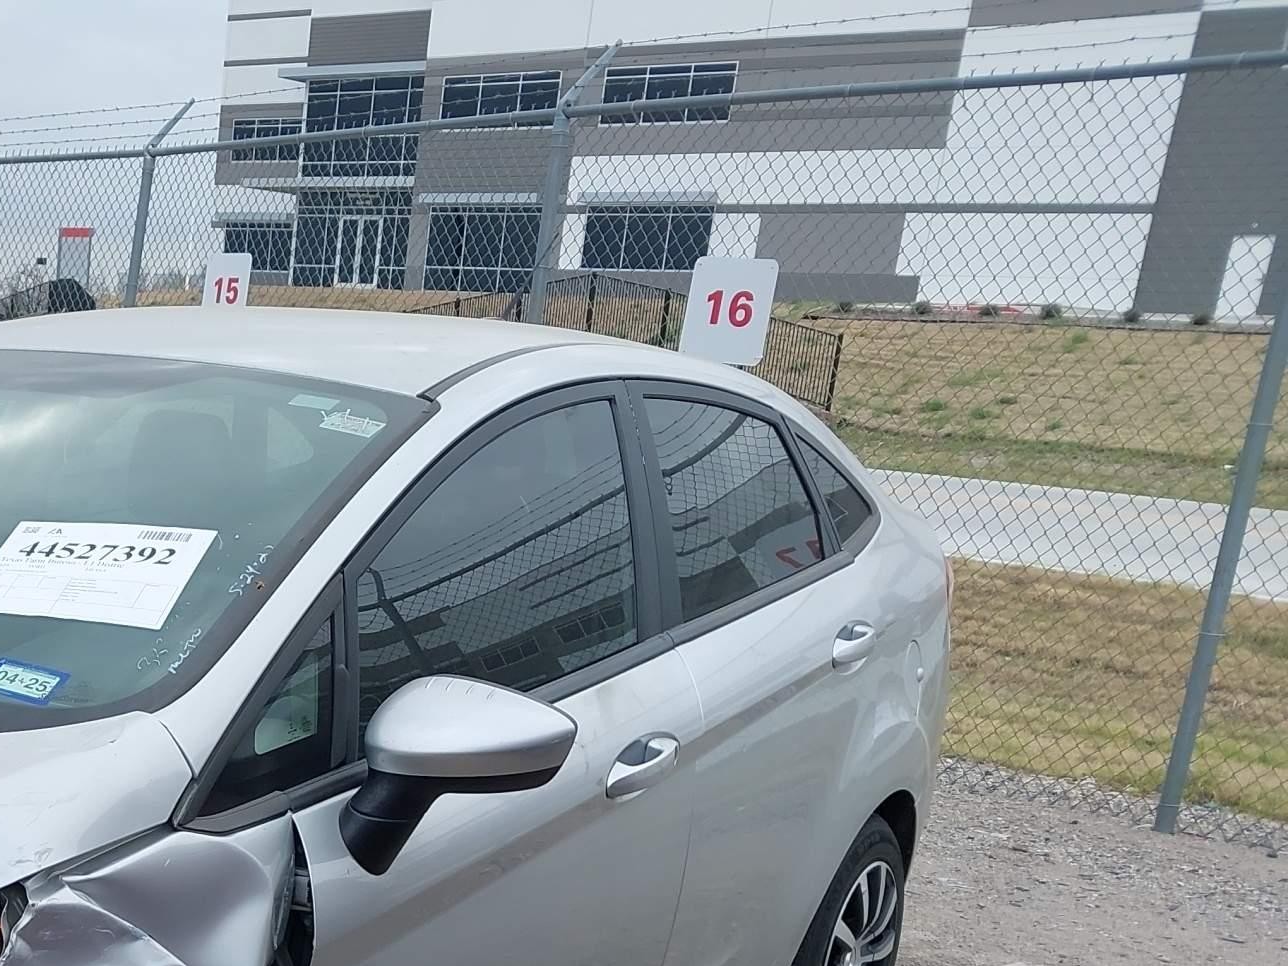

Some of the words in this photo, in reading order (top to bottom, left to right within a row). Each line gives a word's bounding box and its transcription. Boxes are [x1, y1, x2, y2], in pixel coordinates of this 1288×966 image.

[213, 276, 241, 305] 15
[706, 289, 755, 328] 16
[17, 541, 177, 565] 44527392
